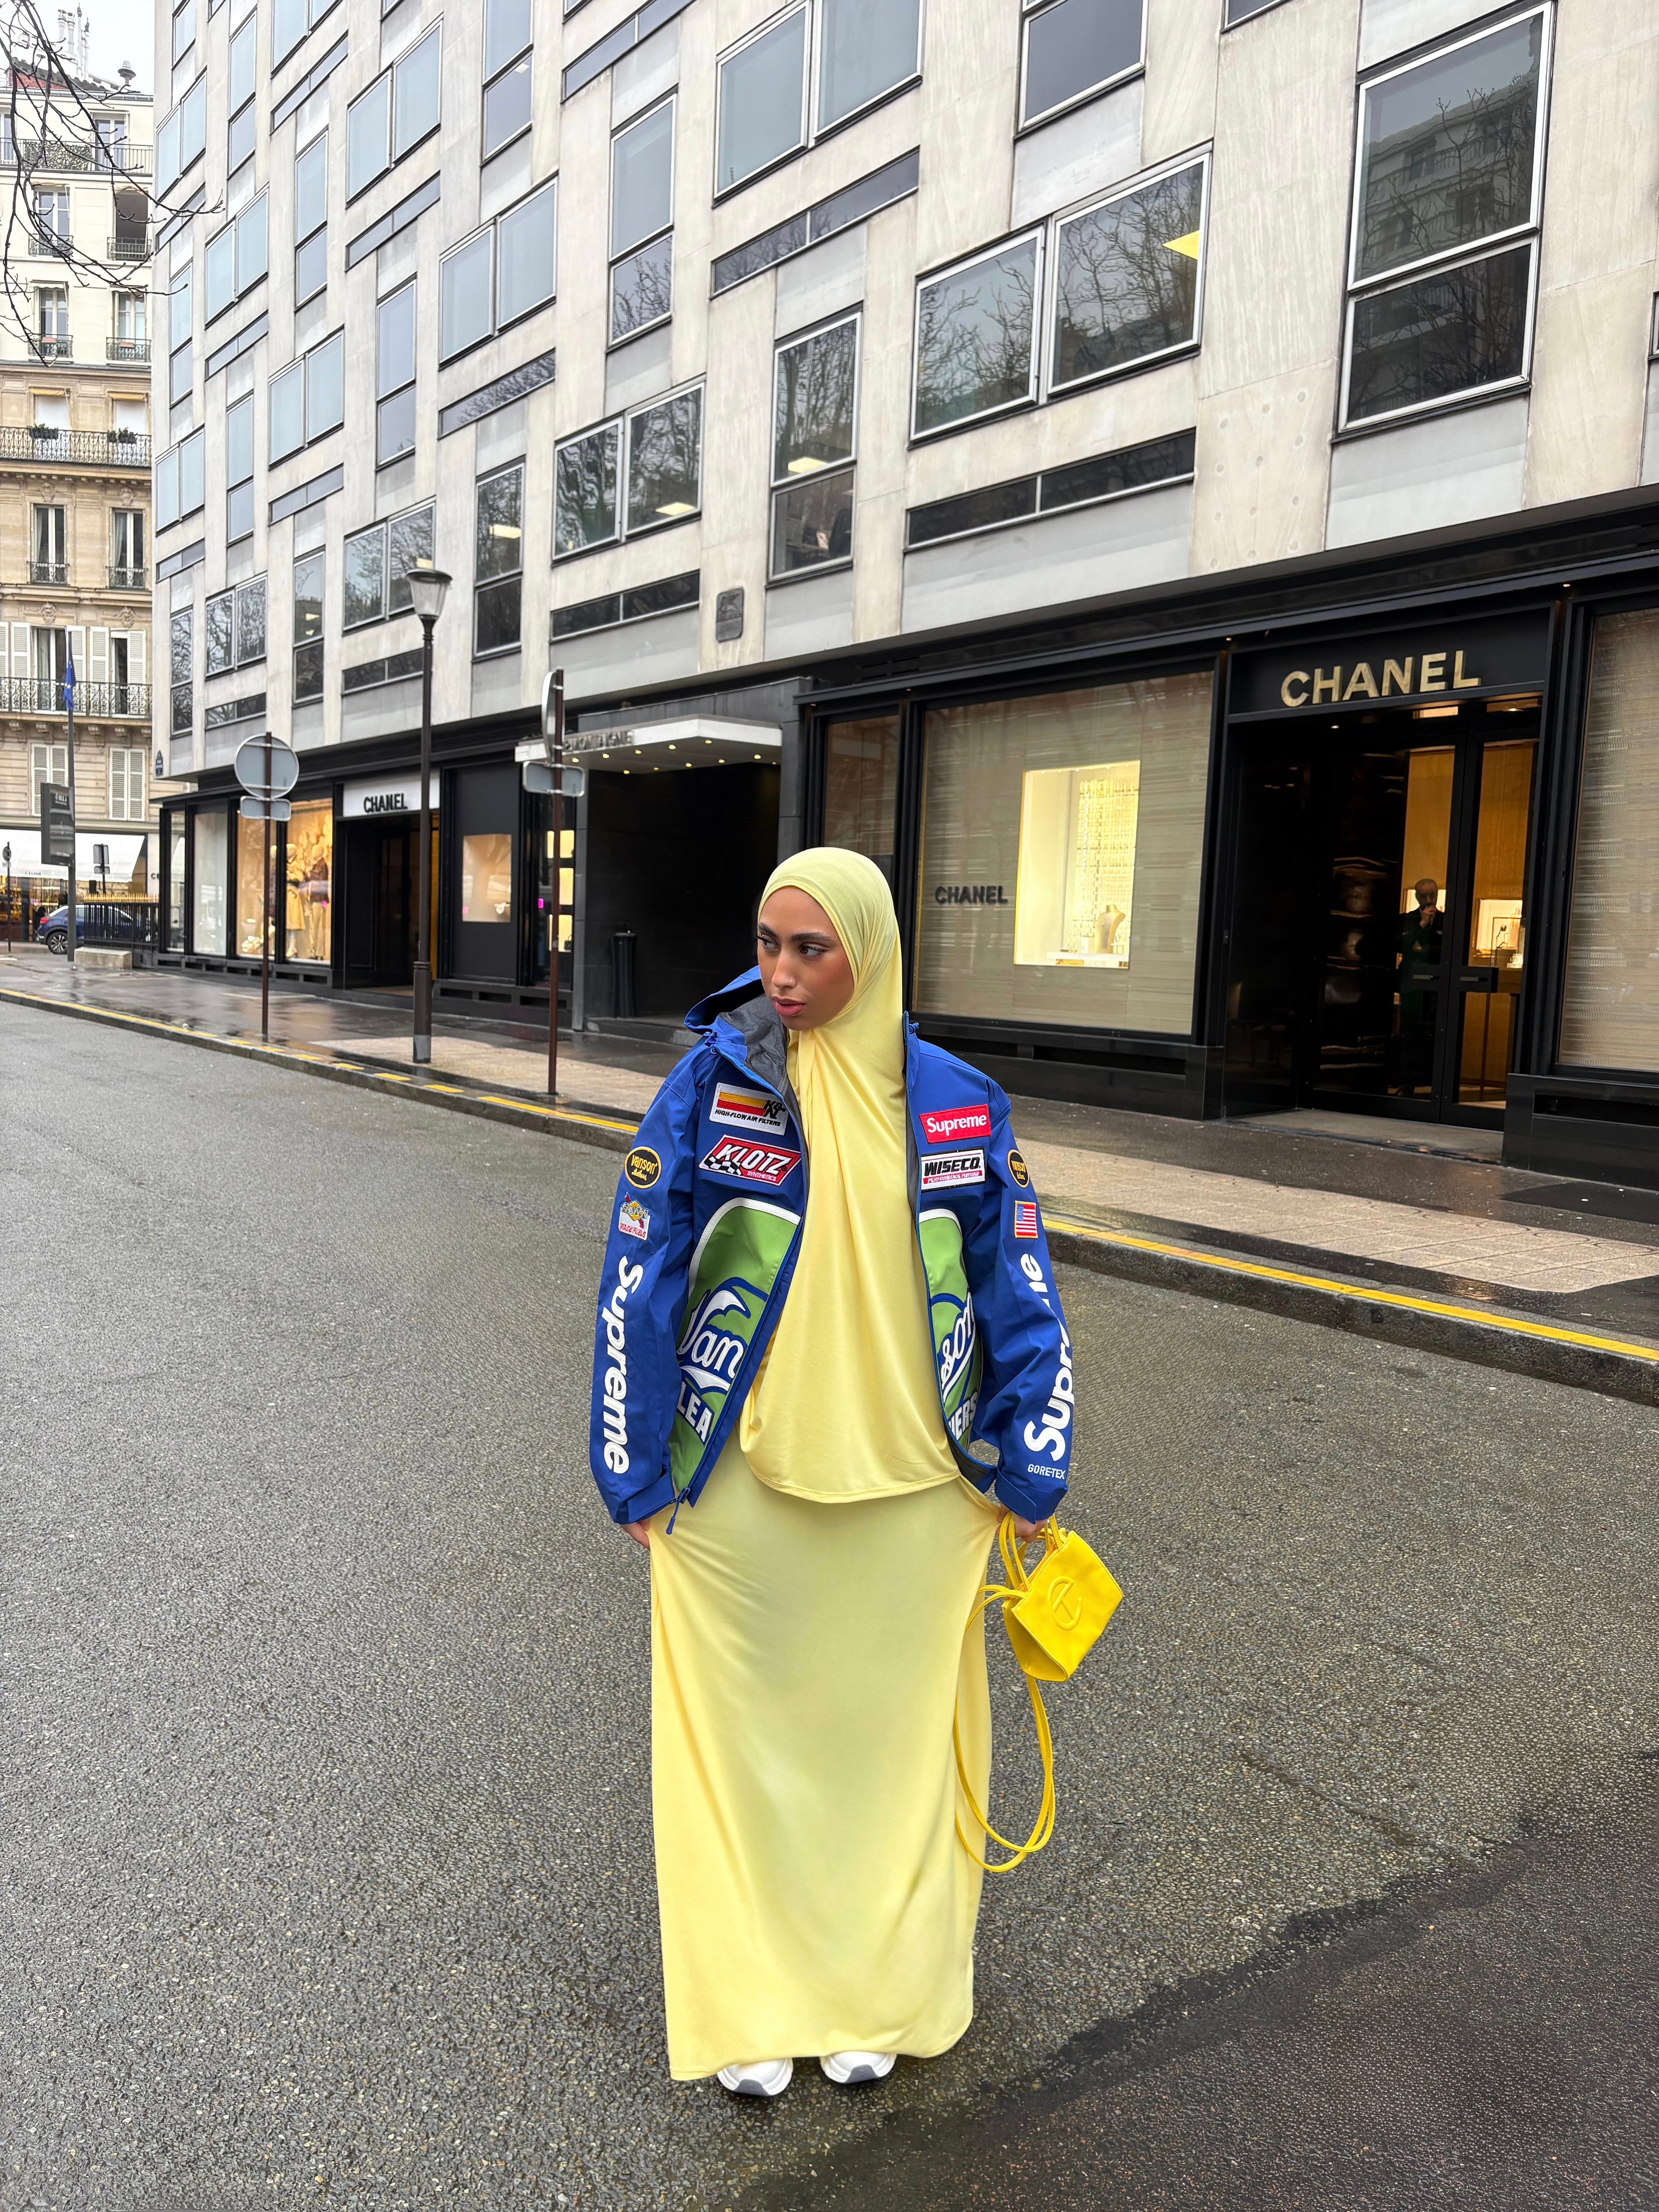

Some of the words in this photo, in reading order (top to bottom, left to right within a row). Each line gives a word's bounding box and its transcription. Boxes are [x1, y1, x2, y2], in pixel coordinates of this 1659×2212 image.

[1281, 650, 1481, 707] CHANEL
[364, 793, 408, 813] CHANEL
[935, 886, 1007, 904] CHANEL
[715, 1109, 747, 1120] HIGH-FLOW
[758, 1117, 781, 1126] FILTERS
[927, 1115, 987, 1136] Supreme
[715, 1144, 792, 1175] KLOTZ
[747, 1171, 777, 1181] SYNTHETICS
[928, 1174, 961, 1183] PERFORMANCE
[632, 1227, 646, 1238] FUELS
[602, 1255, 643, 1474] Supreme
[677, 1381, 712, 1442] LEA
[1027, 1464, 1065, 1480] GORE-TEX
